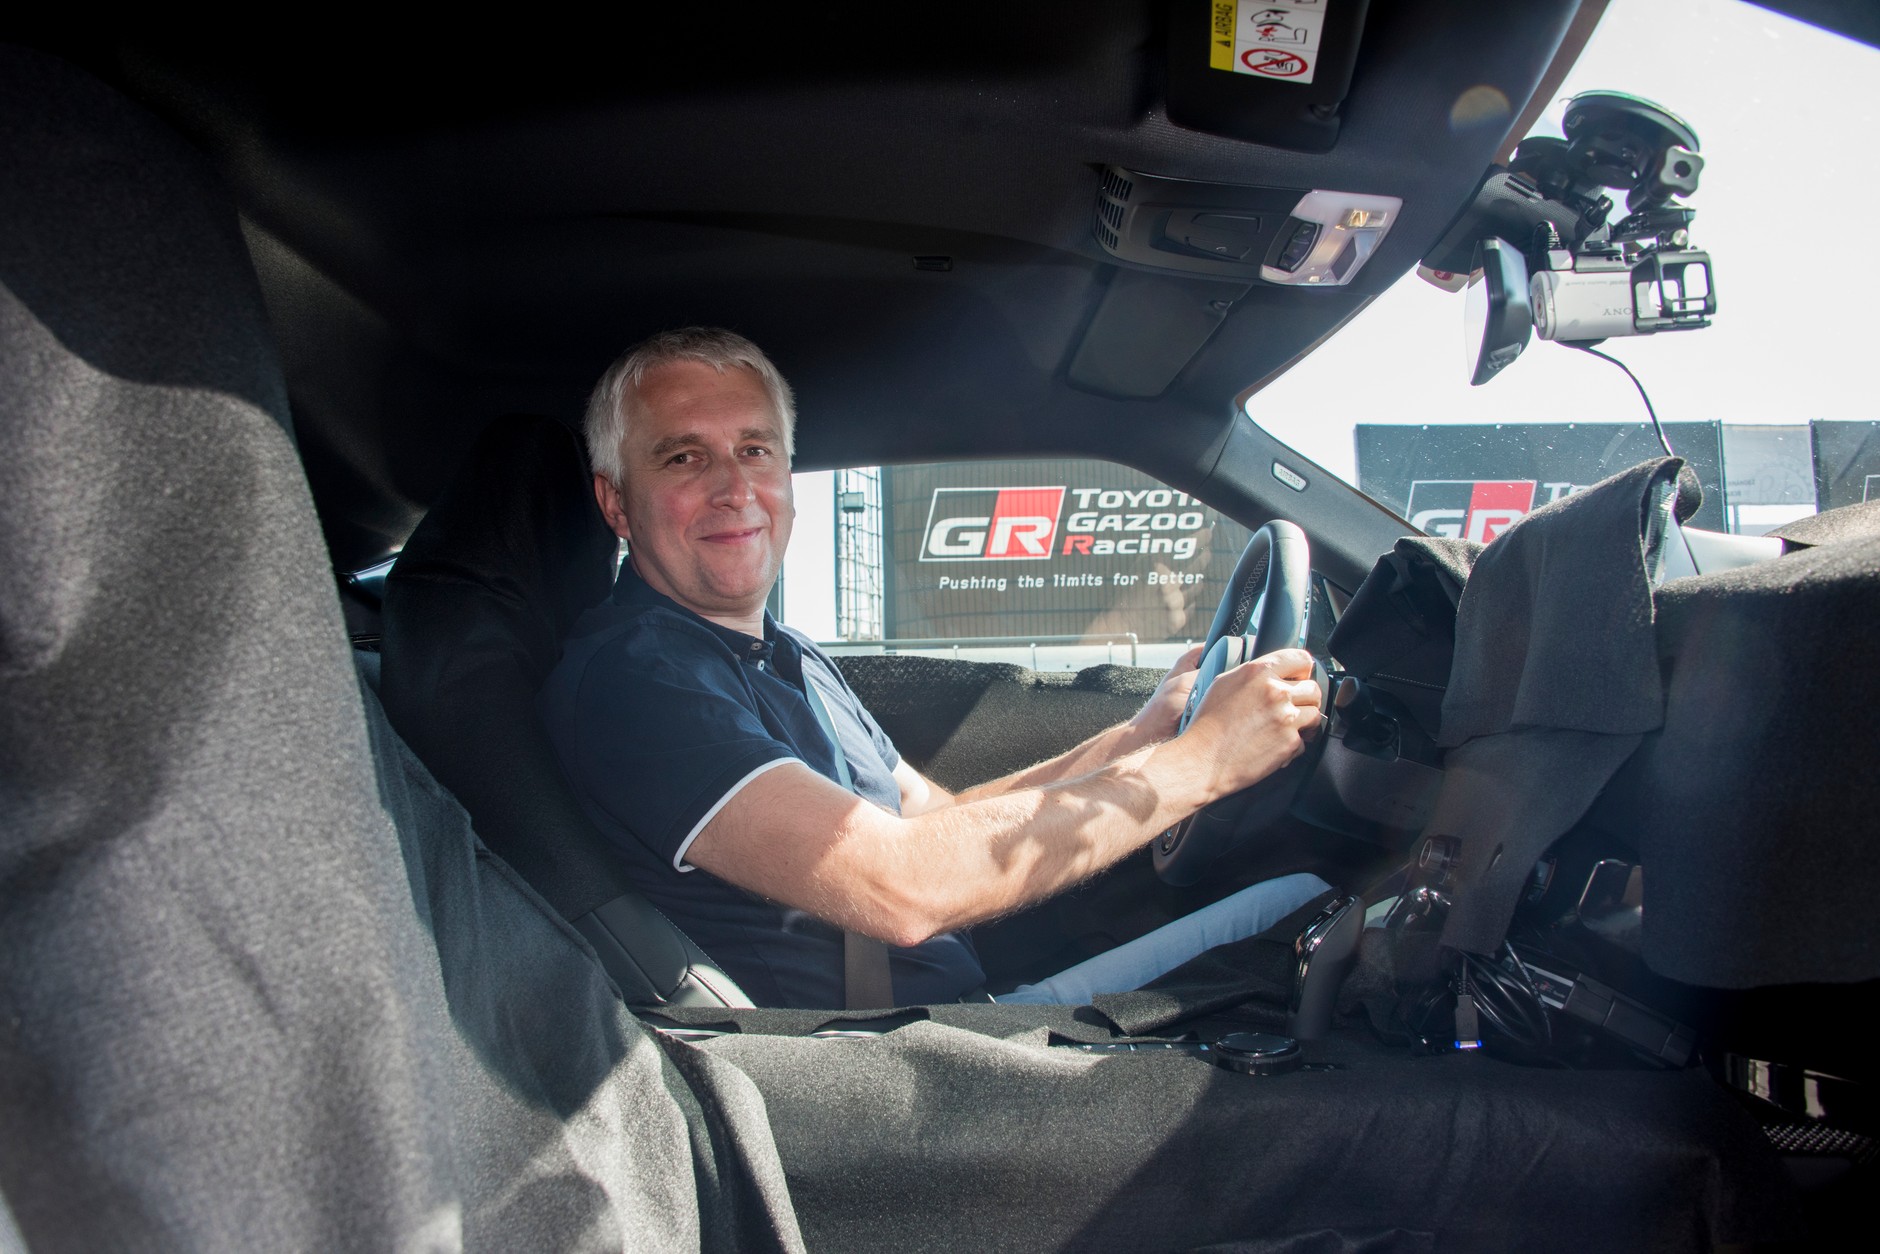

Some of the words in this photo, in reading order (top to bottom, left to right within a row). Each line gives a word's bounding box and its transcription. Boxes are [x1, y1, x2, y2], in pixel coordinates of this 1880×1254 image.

[1214, 3, 1233, 38] AIRBAG
[1601, 306, 1643, 317] SONY
[1066, 511, 1204, 532] GAZOO
[927, 516, 1053, 556] GR
[1062, 533, 1198, 560] Racing
[939, 575, 1007, 591] Pushing
[1017, 574, 1044, 588] the
[1053, 573, 1103, 588] limits
[1112, 572, 1139, 586] for
[1147, 571, 1205, 586] Better
